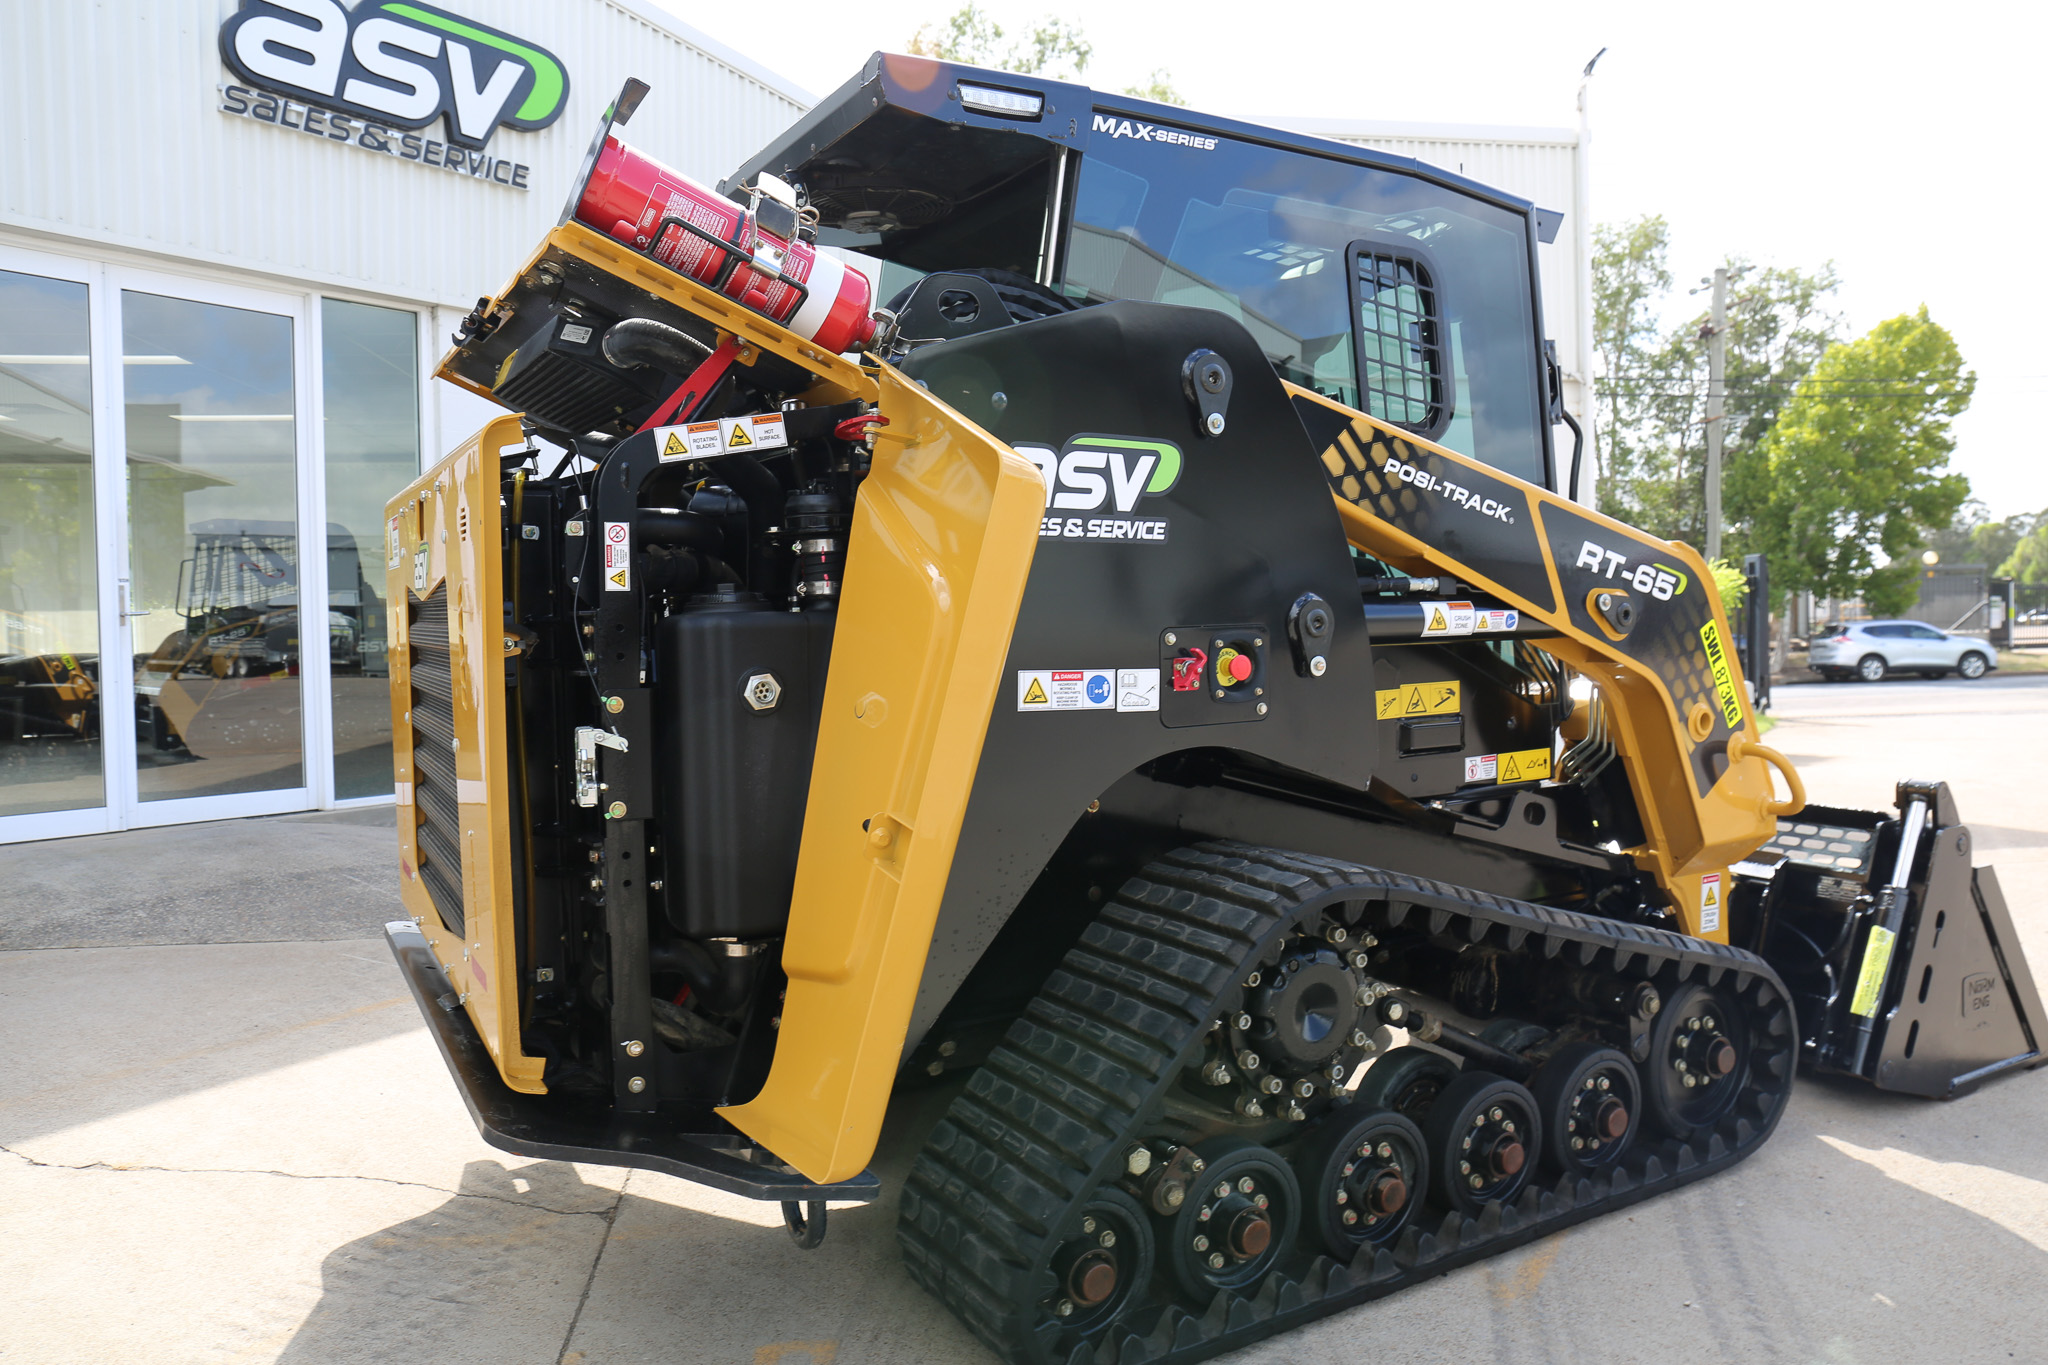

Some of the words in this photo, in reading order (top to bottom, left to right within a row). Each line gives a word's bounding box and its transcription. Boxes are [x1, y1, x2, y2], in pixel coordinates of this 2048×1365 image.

[233, 0, 526, 141] asv
[358, 123, 392, 155] &
[399, 135, 530, 190] SERVICE
[693, 436, 718, 444] ROTATING
[1063, 518, 1085, 538] &
[1086, 519, 1166, 541] SERVICE
[1576, 540, 1677, 602] RT-65
[1704, 625, 1722, 668] SWL
[1715, 667, 1738, 722] 873KG
